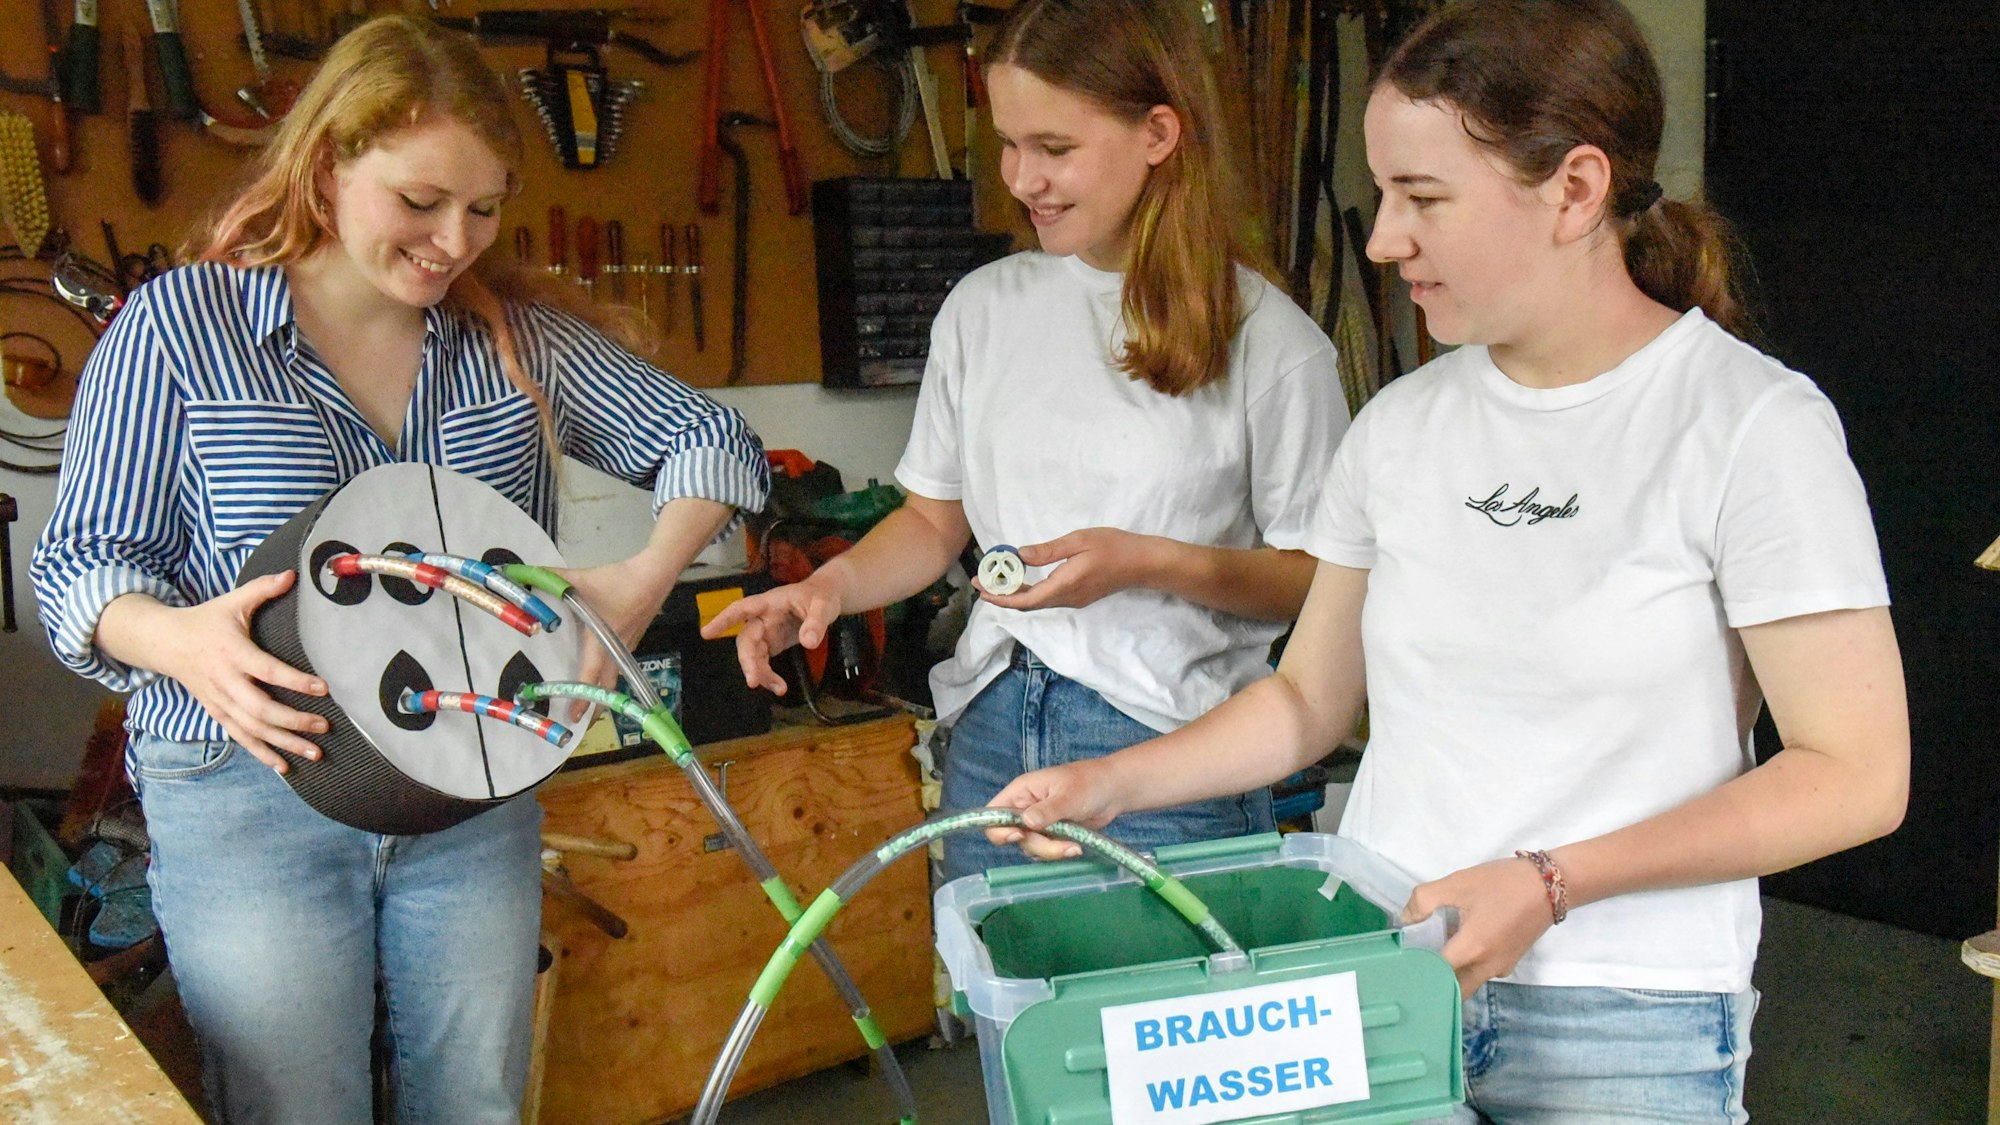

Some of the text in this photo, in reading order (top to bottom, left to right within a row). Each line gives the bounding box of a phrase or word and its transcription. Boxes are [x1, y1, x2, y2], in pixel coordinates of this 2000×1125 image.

[1465, 483, 1580, 527] Los Angeles
[637, 658, 672, 671] ZONE
[1134, 995, 1332, 1052] BRAUCH-
[1146, 1057, 1333, 1113] WASSER
